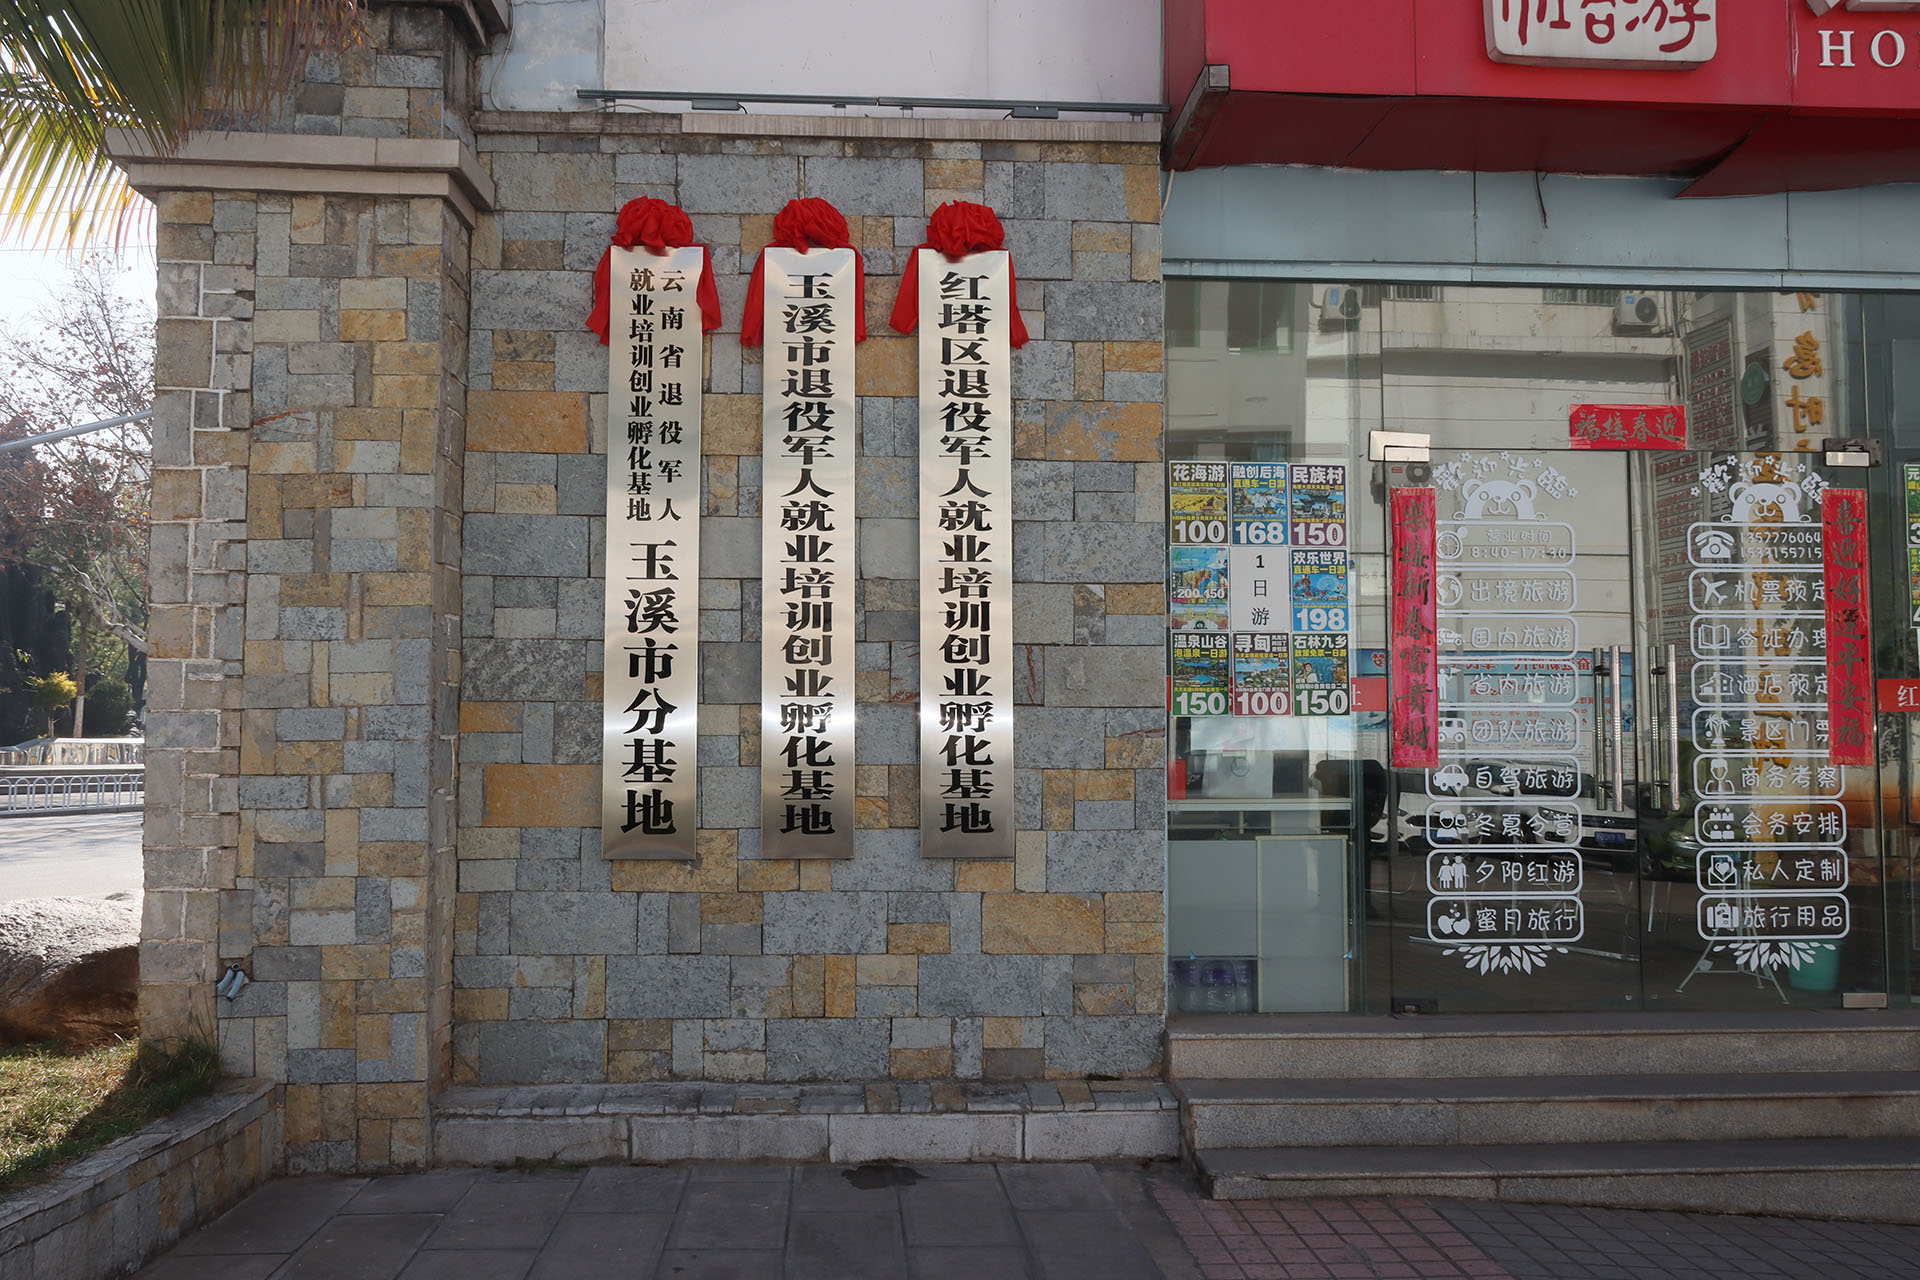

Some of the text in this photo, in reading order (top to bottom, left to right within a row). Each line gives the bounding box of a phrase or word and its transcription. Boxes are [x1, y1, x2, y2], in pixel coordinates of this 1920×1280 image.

[626, 267, 655, 522] 就业培训创业孵化基地
[656, 270, 686, 522] 云南省退役军人
[1173, 464, 1225, 482] 花海游
[1233, 465, 1285, 479] 融创后海
[1233, 479, 1286, 488] 直通车一日游
[1292, 467, 1344, 484] 民族村
[1175, 520, 1225, 542] 100
[1235, 522, 1284, 543] 168
[1294, 523, 1344, 545] 150
[1486, 527, 1552, 543] 营业时间
[779, 273, 836, 834] 玉溪市退役军人就业培训创业孵化基地
[938, 271, 995, 834] 红塔区退役军人就业培训创业孵化基地
[1293, 551, 1345, 565] 欢乐世界
[1471, 546, 1566, 559] 8:40-17:30
[1293, 565, 1346, 575] 直通车一日游
[1470, 579, 1570, 602] 出境旅游
[1296, 609, 1345, 631] 198
[1174, 635, 1227, 648] 温泉山谷
[1235, 634, 1270, 652] 寻甸
[1294, 634, 1347, 649] 石林九乡
[1471, 625, 1570, 649] 国内旅游
[620, 539, 680, 835] 玉溪市分基地
[1472, 672, 1570, 696] 省内旅游
[1176, 692, 1225, 715] 150
[1237, 692, 1288, 715] 100
[1296, 690, 1348, 714] 150
[1471, 718, 1572, 743] 团队旅游
[1475, 765, 1574, 789] 自驾旅游
[1741, 765, 1837, 788] 商务考察
[1475, 812, 1574, 836] 冬夏令营
[1741, 811, 1840, 835] 会务安排
[1476, 860, 1575, 884] 夕阳红游
[1743, 858, 1841, 882] 私人定制
[1476, 907, 1576, 932] 蜜月旅行
[1743, 905, 1843, 929] 旅行用品
